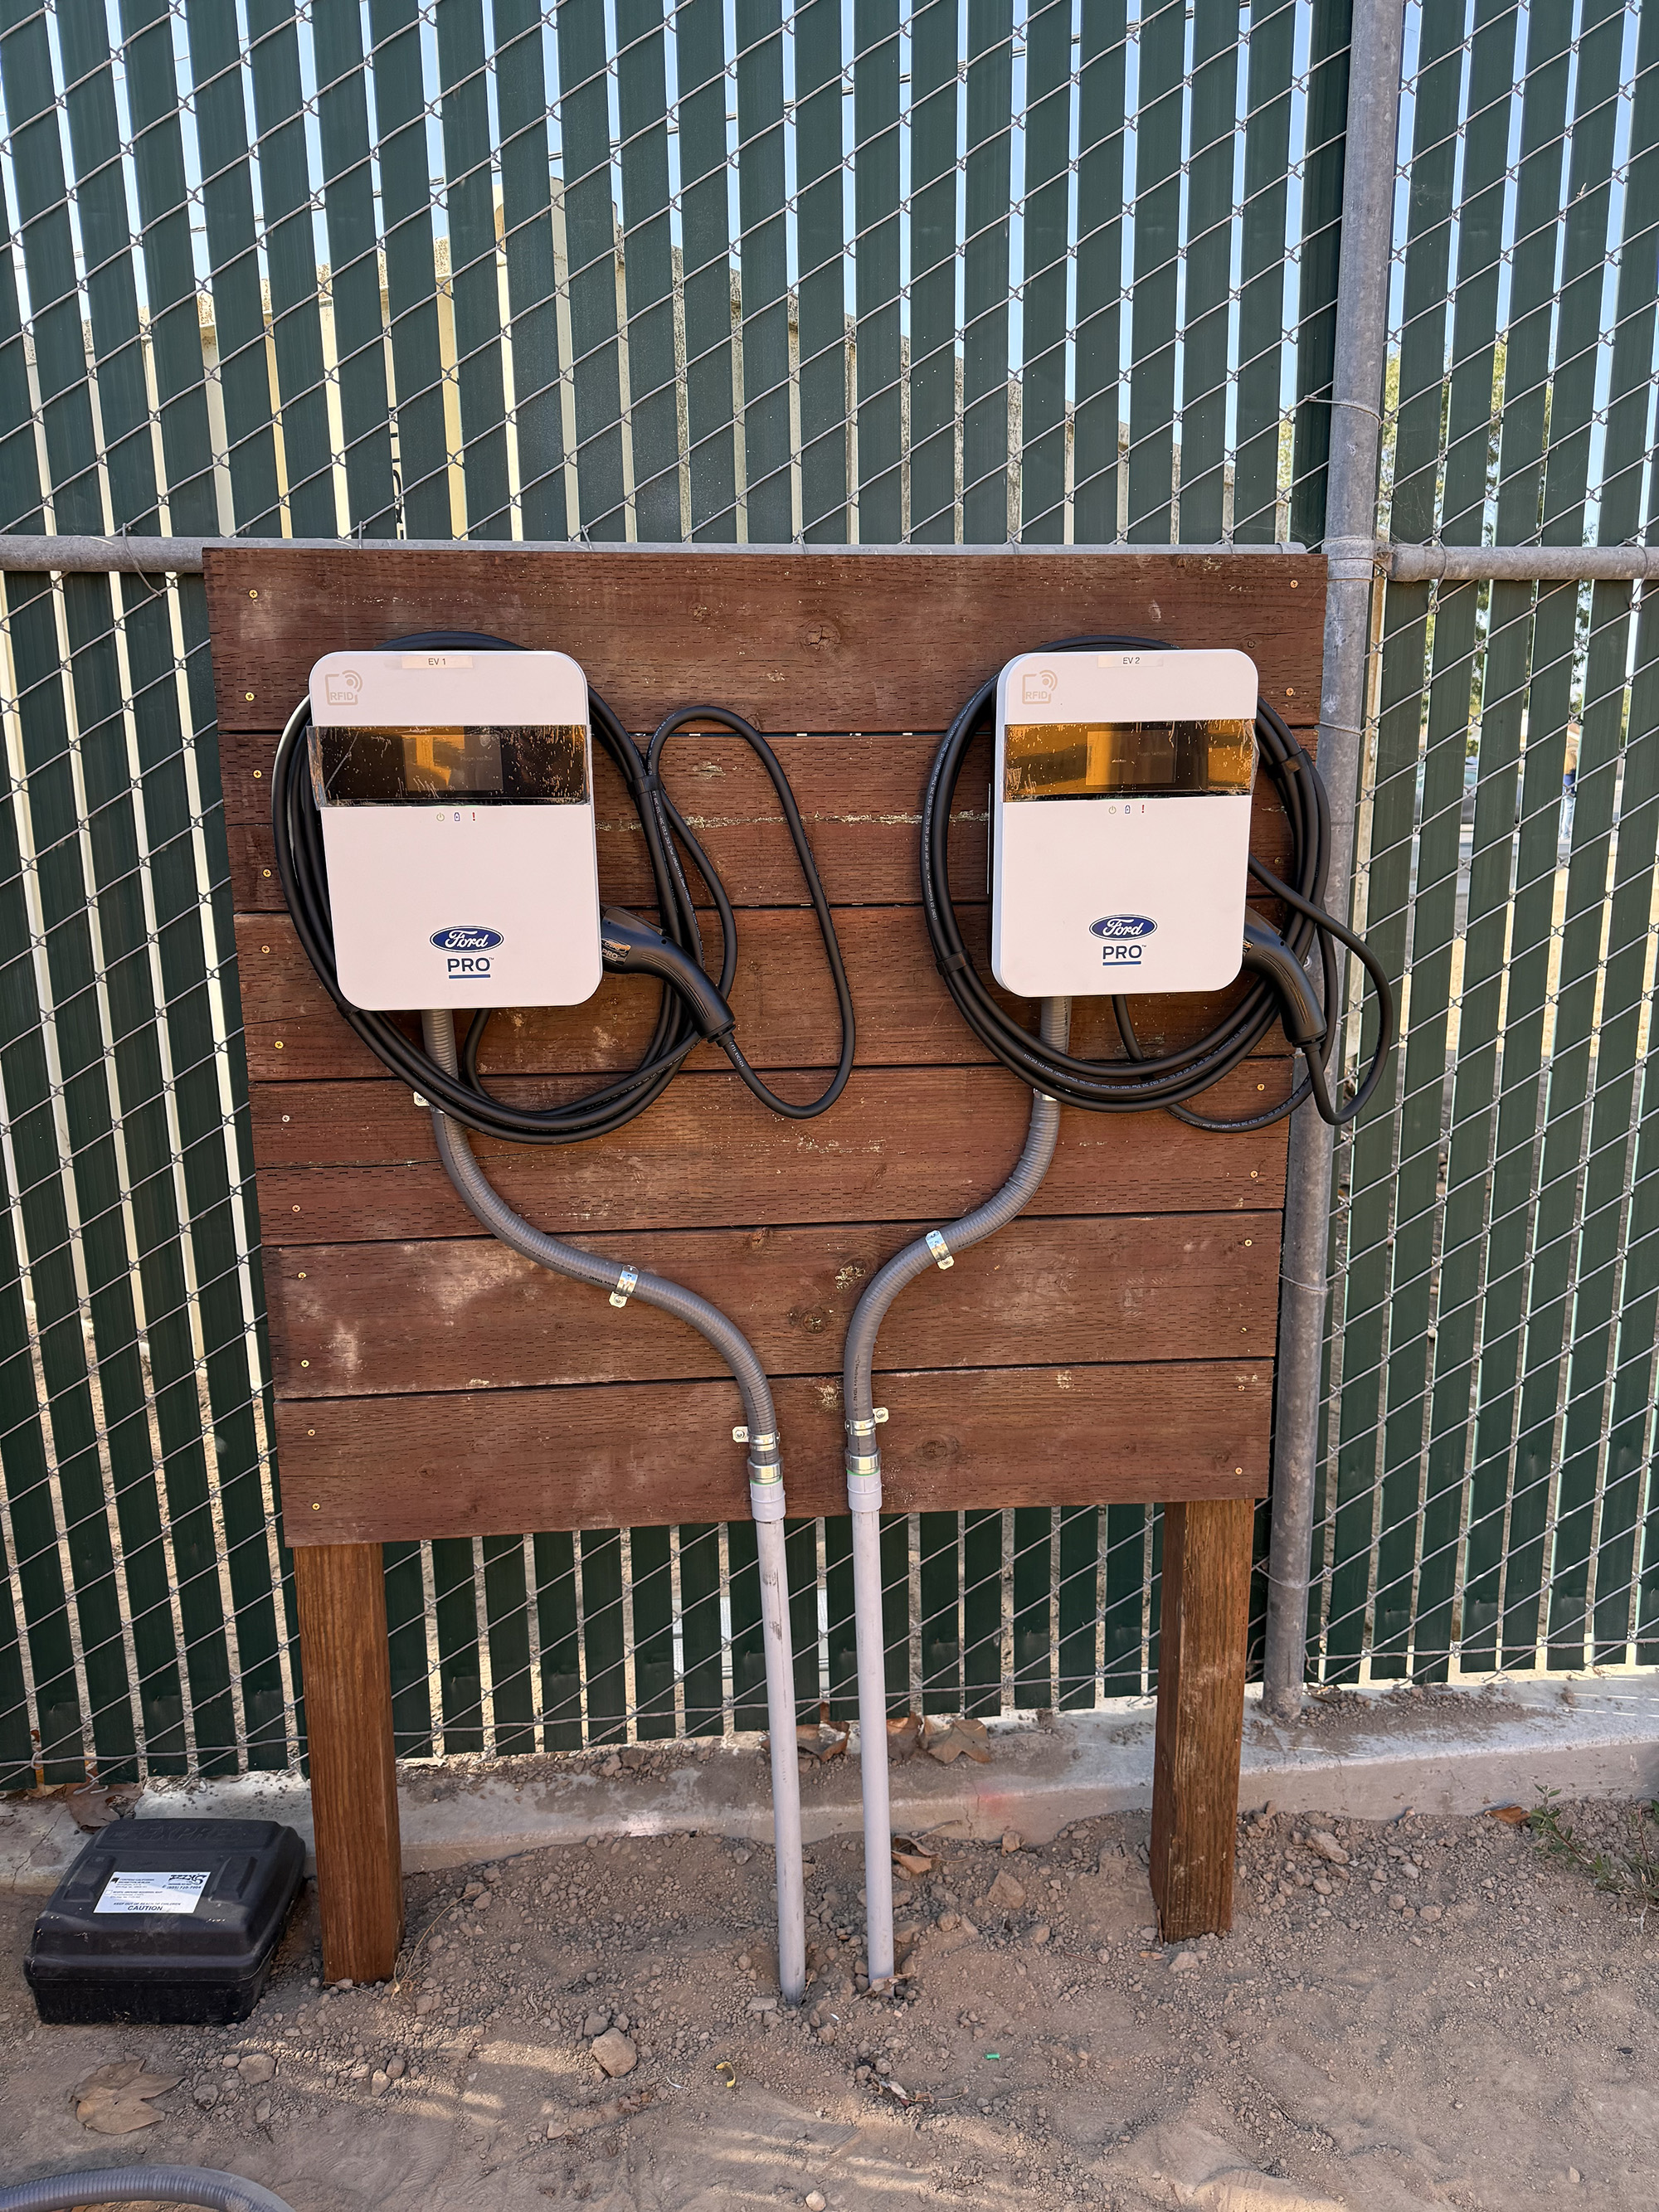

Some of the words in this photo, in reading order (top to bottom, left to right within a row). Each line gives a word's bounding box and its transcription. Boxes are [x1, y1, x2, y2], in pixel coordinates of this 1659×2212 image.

[428, 658, 440, 666] EV
[330, 692, 354, 701] RFID
[1025, 691, 1048, 699] RFID
[1102, 918, 1144, 936] Ford
[445, 930, 489, 948] Ford
